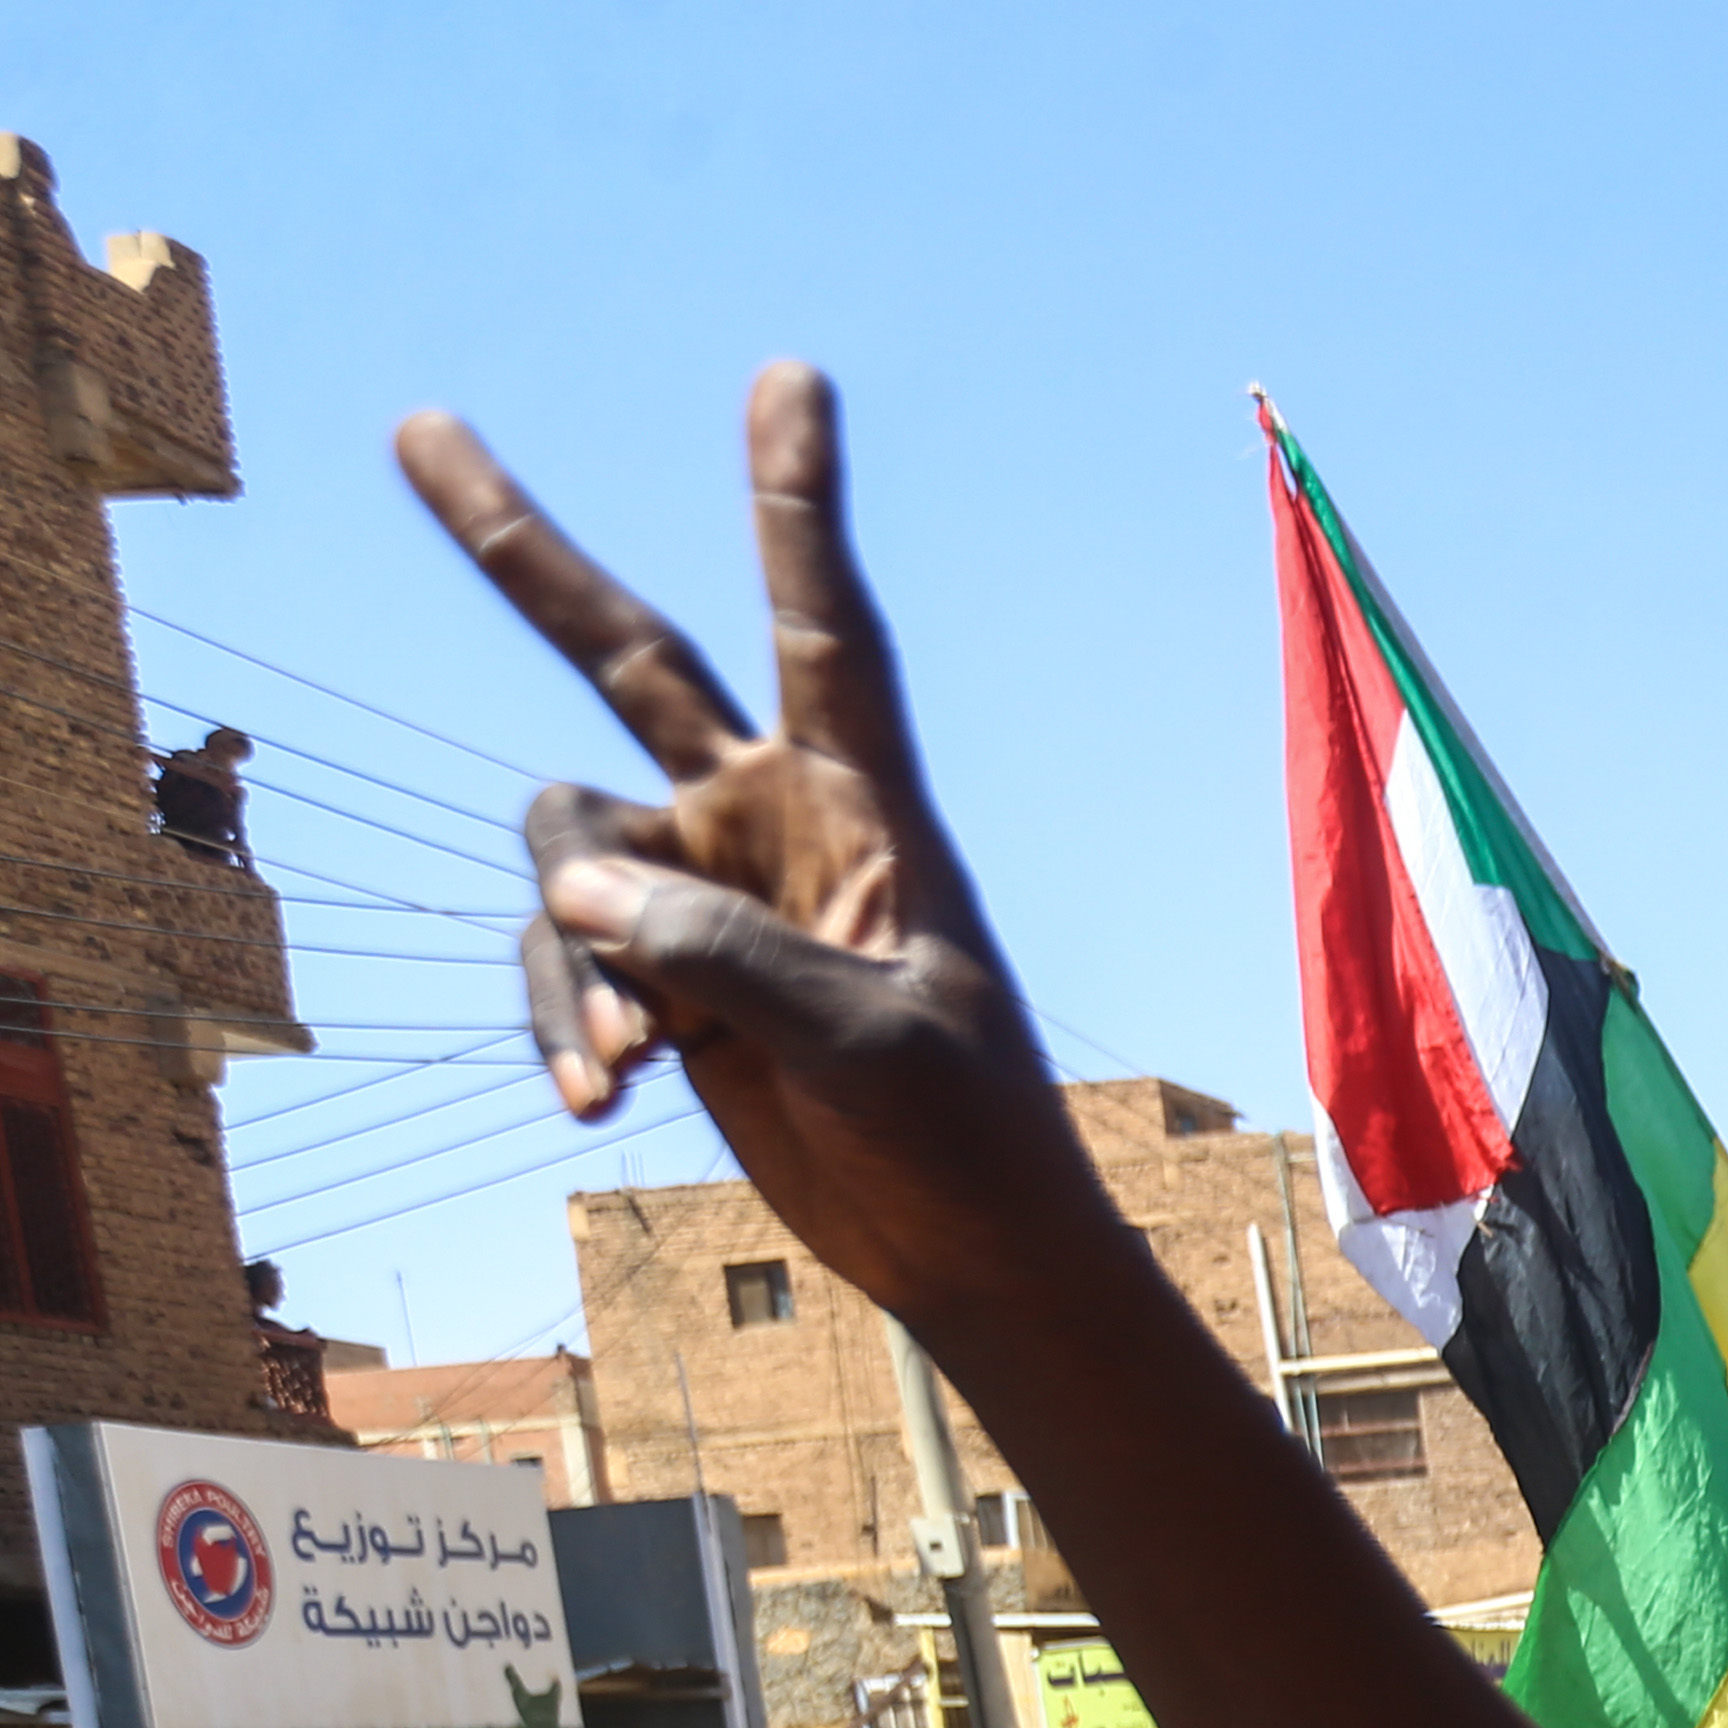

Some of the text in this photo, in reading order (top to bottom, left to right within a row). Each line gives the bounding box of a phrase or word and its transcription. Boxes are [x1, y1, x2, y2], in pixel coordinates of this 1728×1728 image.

[291, 1508, 538, 1570] مركز توزيع
[301, 1585, 552, 1649] دواجن شبيكة
